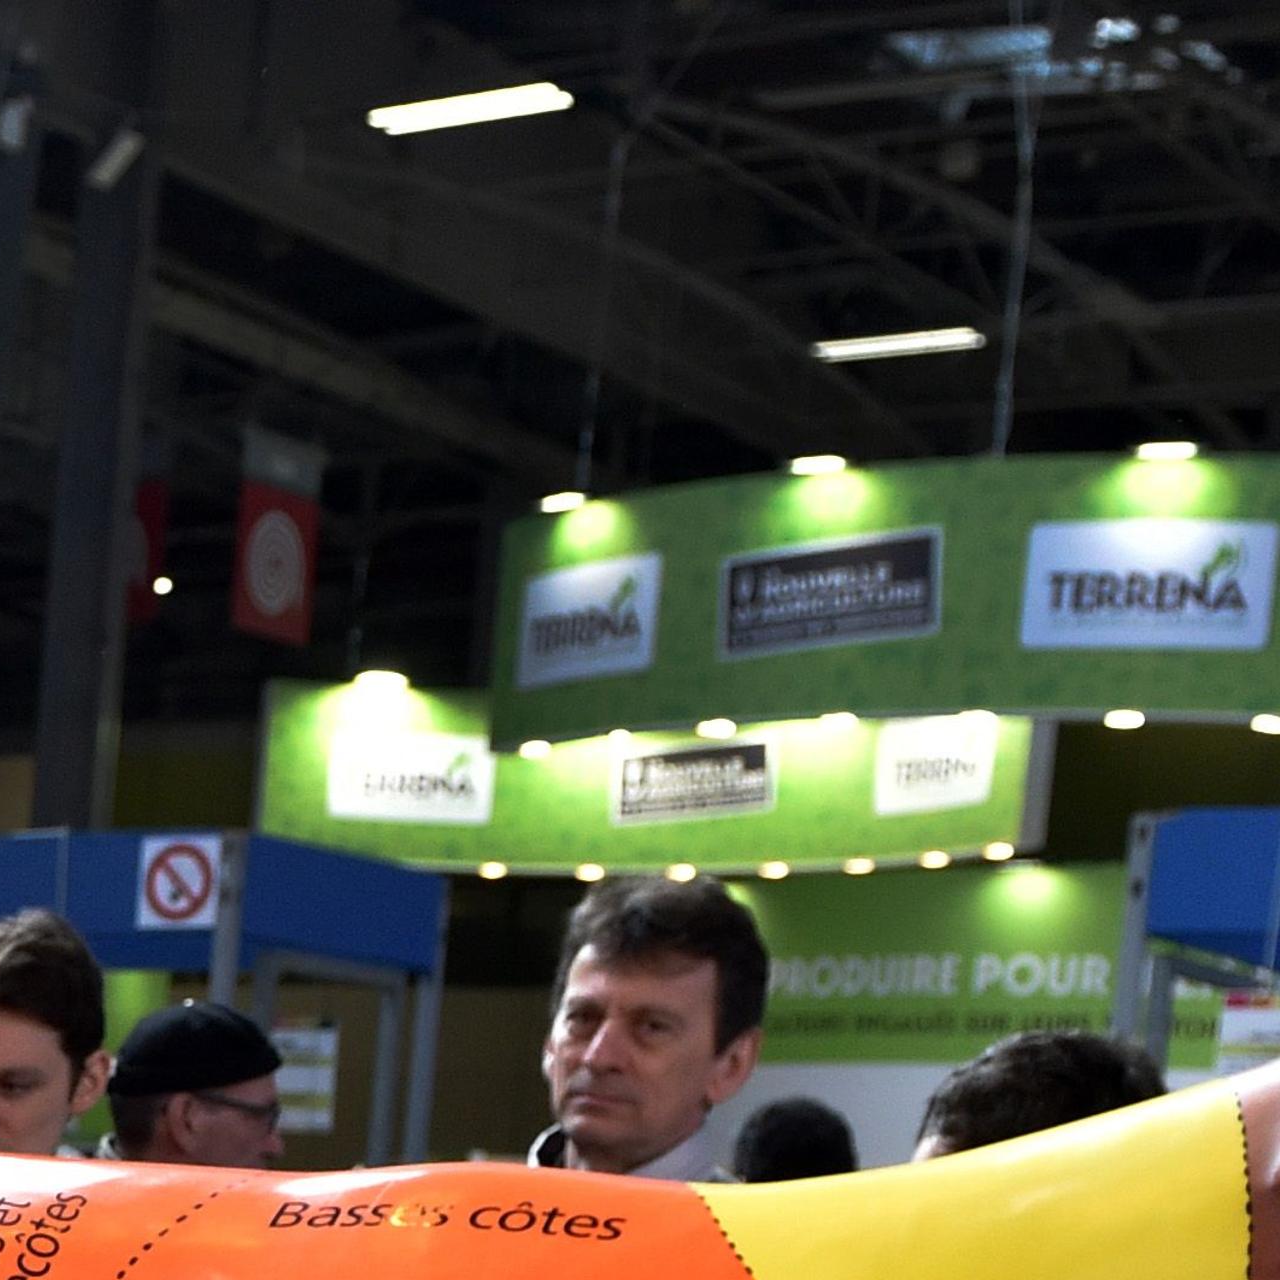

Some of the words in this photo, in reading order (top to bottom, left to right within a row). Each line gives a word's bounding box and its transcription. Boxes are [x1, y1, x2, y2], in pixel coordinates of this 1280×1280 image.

[1047, 566, 1247, 616] TERRENA
[770, 955, 960, 996] PRODUIRE
[973, 952, 1112, 996] POUR
[469, 1202, 626, 1241] côtes
